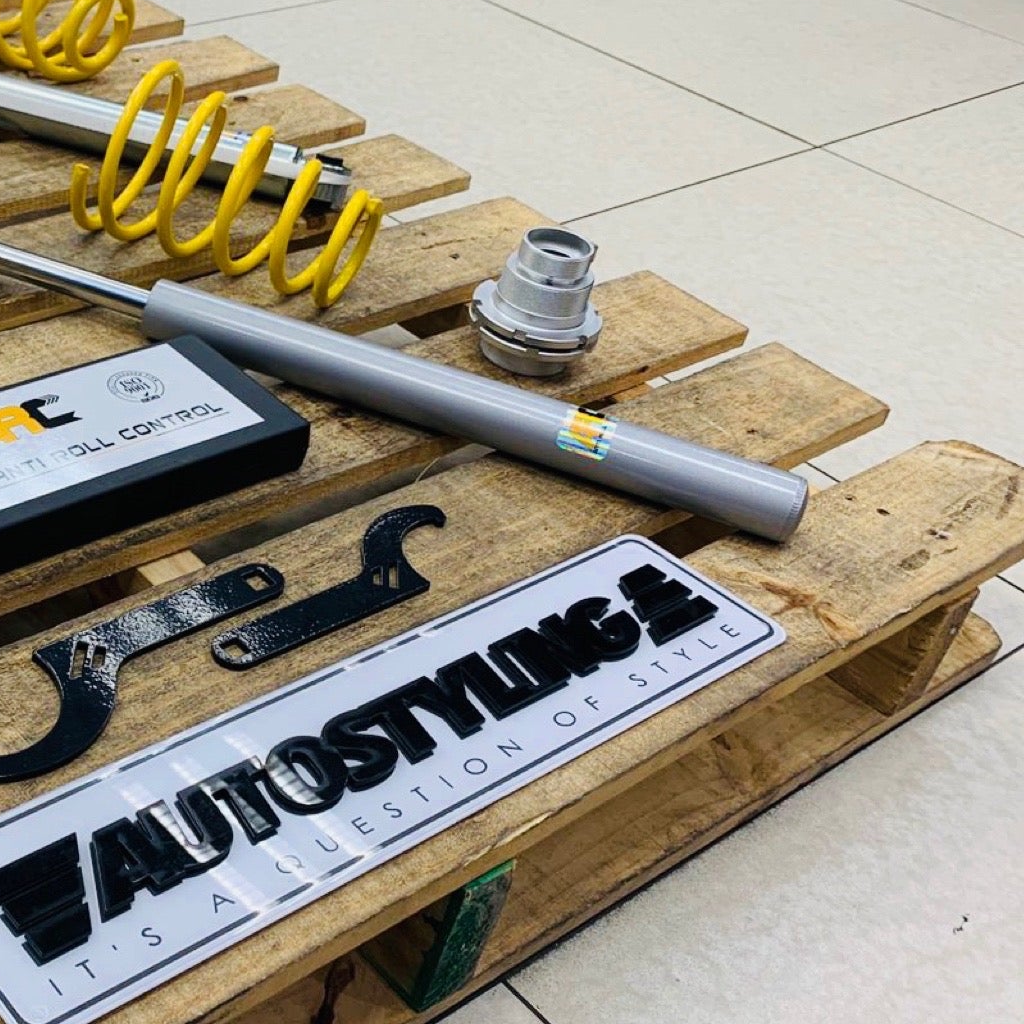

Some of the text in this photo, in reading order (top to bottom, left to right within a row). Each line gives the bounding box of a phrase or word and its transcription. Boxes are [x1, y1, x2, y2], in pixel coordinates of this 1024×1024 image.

[50, 437, 115, 463] ROLL
[118, 402, 223, 440] CONTROL
[49, 624, 740, 996] IT'S A QUESTION OF STYLE
[89, 596, 641, 923] AUTOSTYLING
